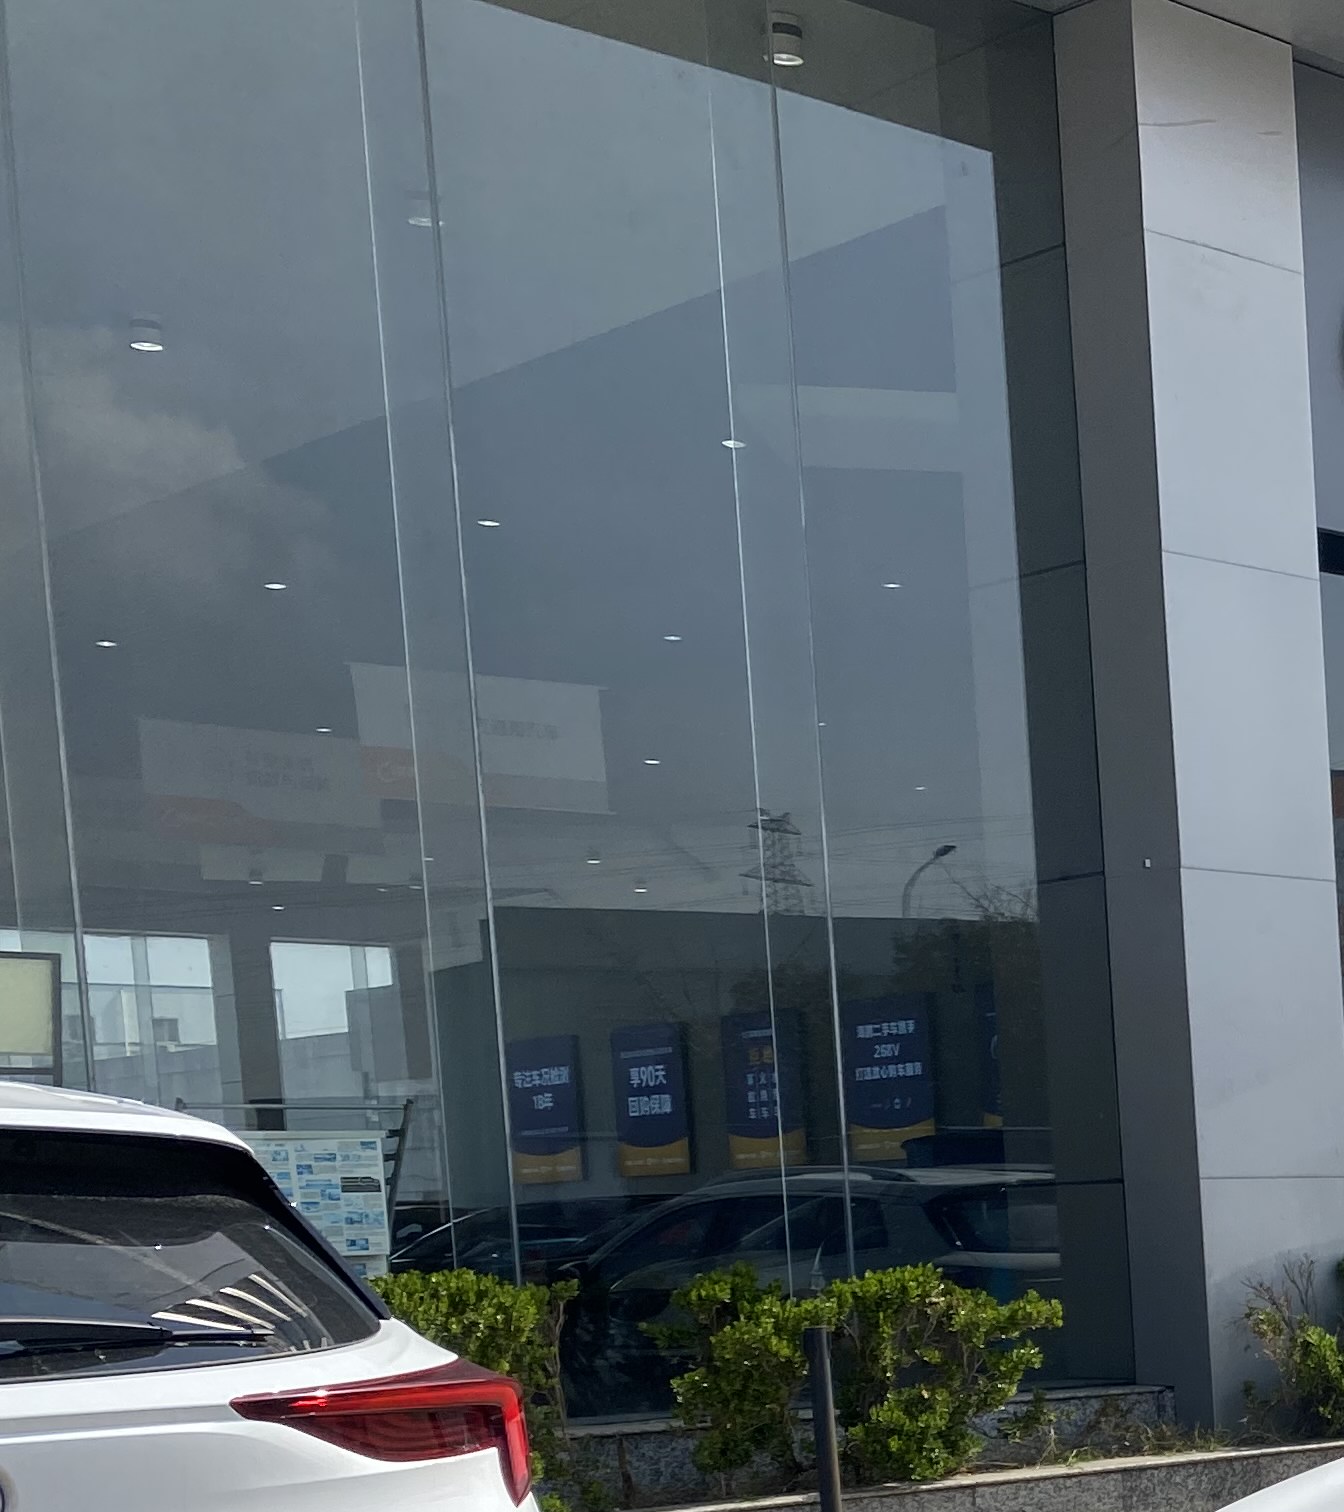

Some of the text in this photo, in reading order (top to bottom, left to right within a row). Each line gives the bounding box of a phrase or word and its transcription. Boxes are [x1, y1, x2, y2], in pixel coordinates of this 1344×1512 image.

[629, 1065, 667, 1088] 享90天
[628, 1094, 673, 1117] 回购保障
